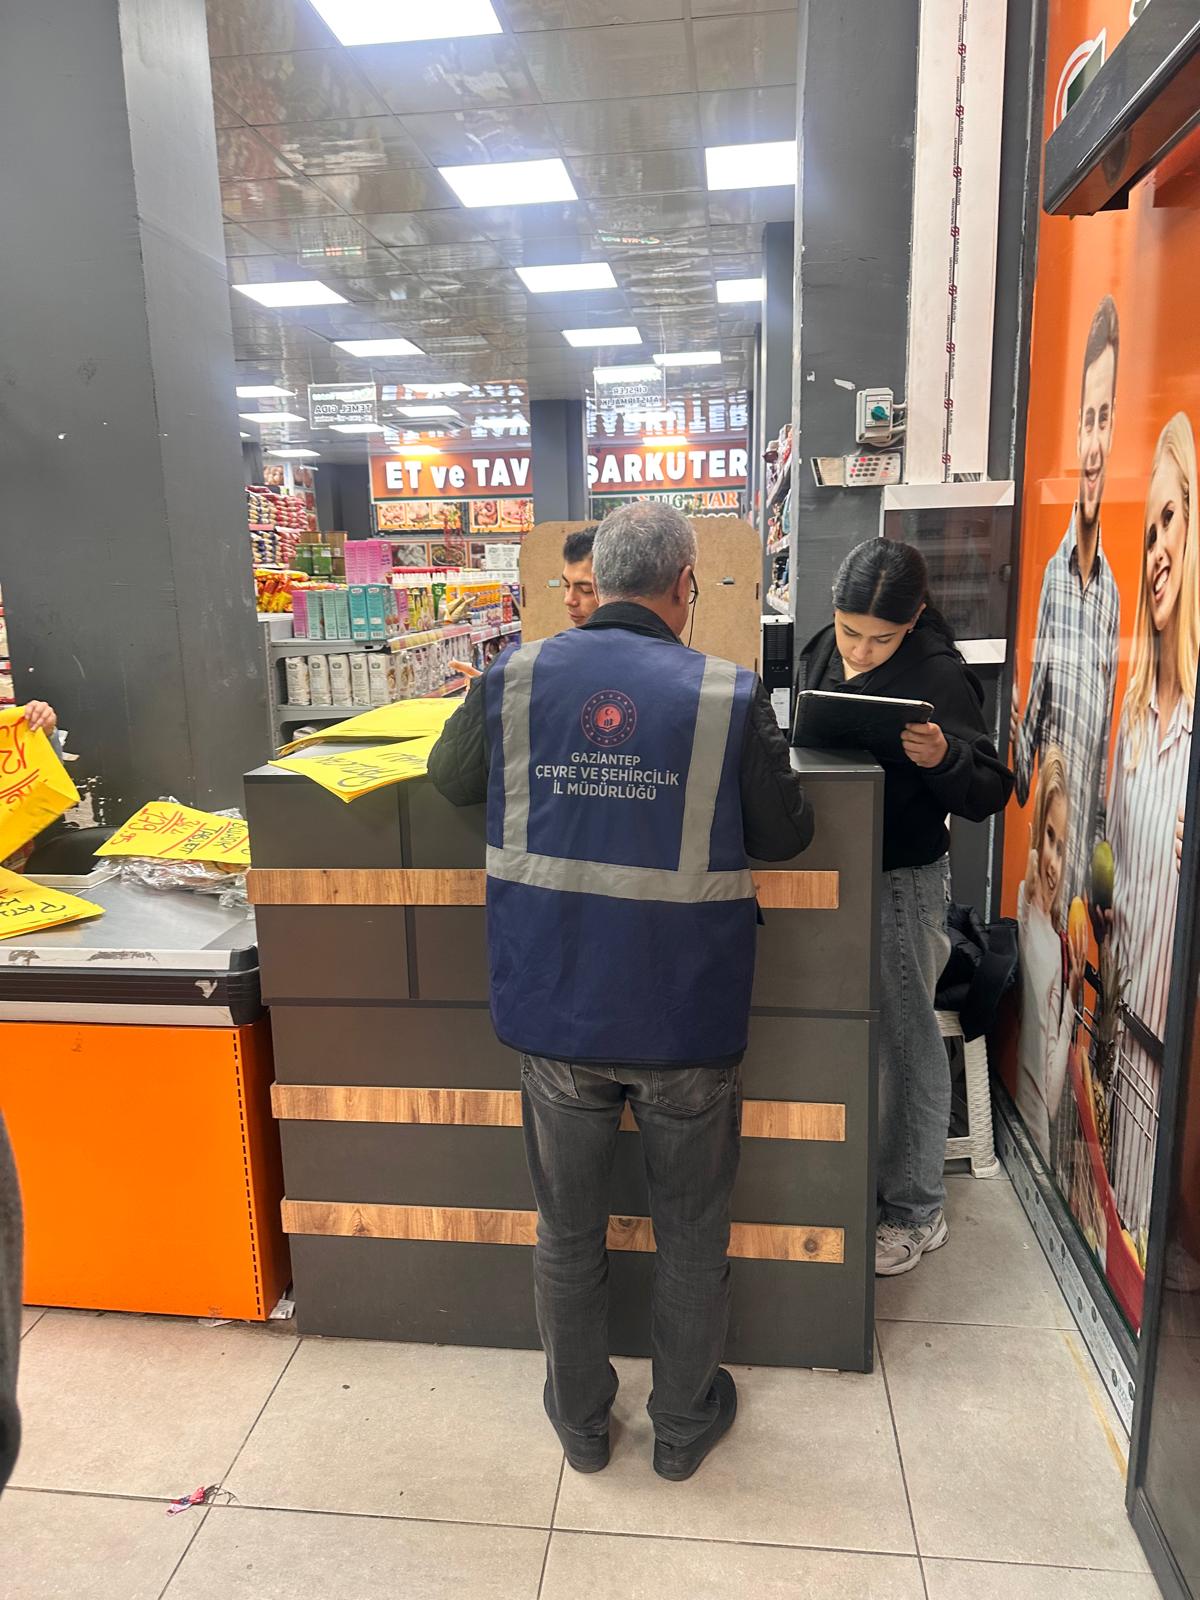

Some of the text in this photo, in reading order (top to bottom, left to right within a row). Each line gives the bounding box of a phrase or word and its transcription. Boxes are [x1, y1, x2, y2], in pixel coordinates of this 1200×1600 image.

[385, 460, 422, 489] ET
[430, 464, 465, 489] ve
[571, 751, 641, 767] GAZİANTEP
[535, 765, 680, 787] ÇEVRE VE ŞEHİRCİLİK
[553, 779, 657, 801] İL MÜDÜRLÜĞÜ
